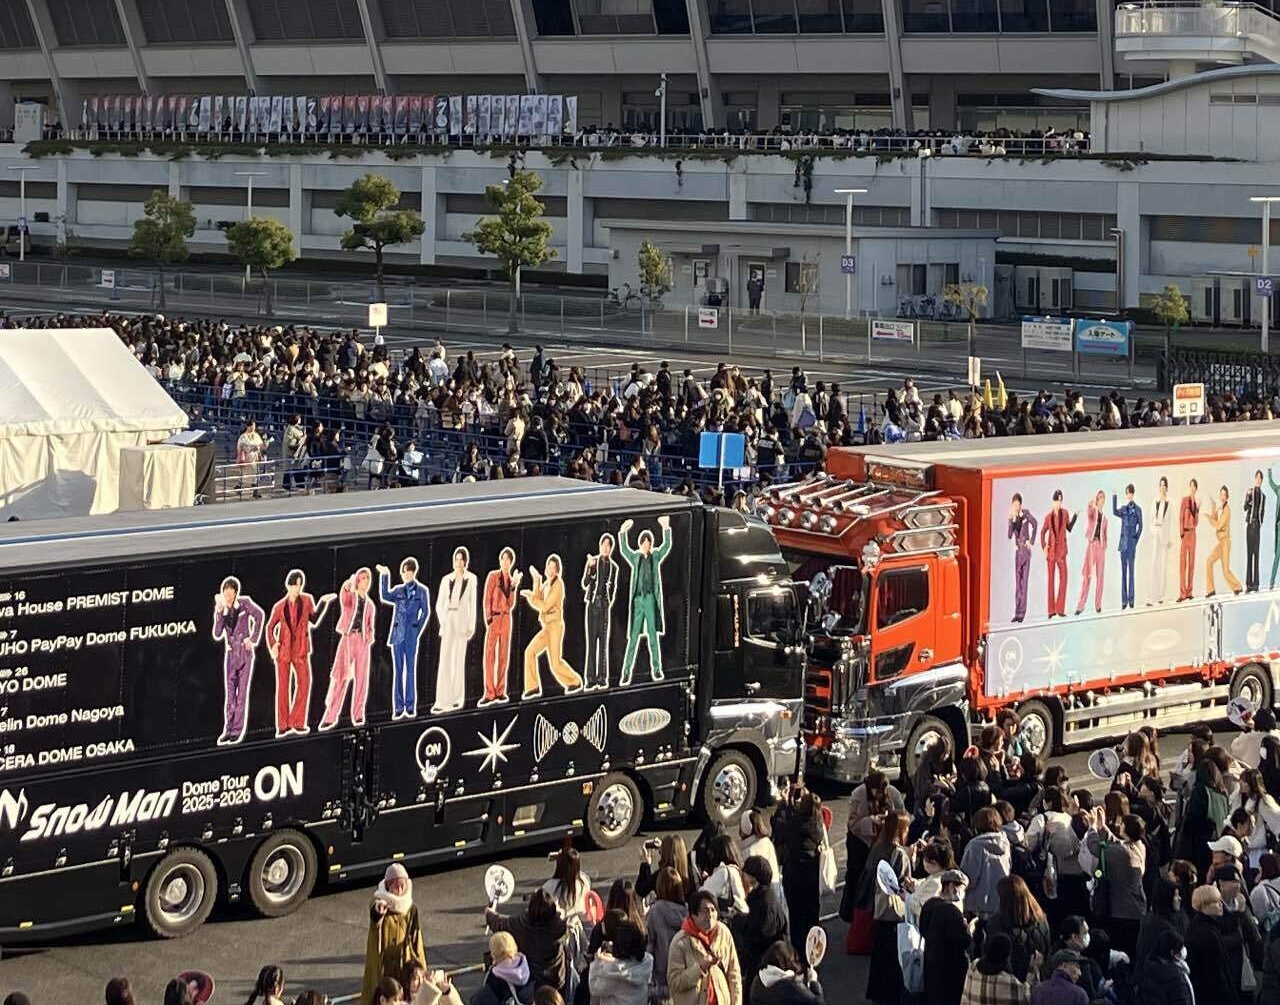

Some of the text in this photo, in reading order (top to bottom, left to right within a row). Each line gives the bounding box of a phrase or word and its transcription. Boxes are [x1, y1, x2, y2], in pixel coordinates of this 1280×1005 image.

[842, 258, 854, 267] D3
[1257, 279, 1272, 289] D2
[17, 600, 63, 616] House
[66, 590, 129, 610] PREMIST
[131, 585, 175, 604] DOME
[30, 635, 83, 654] PayPay
[86, 630, 127, 646] Dome
[129, 619, 197, 641] FUKUOKA
[22, 672, 68, 693] DOME
[25, 712, 68, 729] Dome
[70, 703, 125, 724] Nagoya
[37, 745, 84, 766] DOME
[85, 737, 136, 757] OSAKA
[424, 742, 442, 757] ON
[181, 774, 250, 798] Dome Tour
[253, 760, 305, 802] ON
[181, 787, 252, 814] 2025-2026
[19, 788, 179, 842] Snow Man
